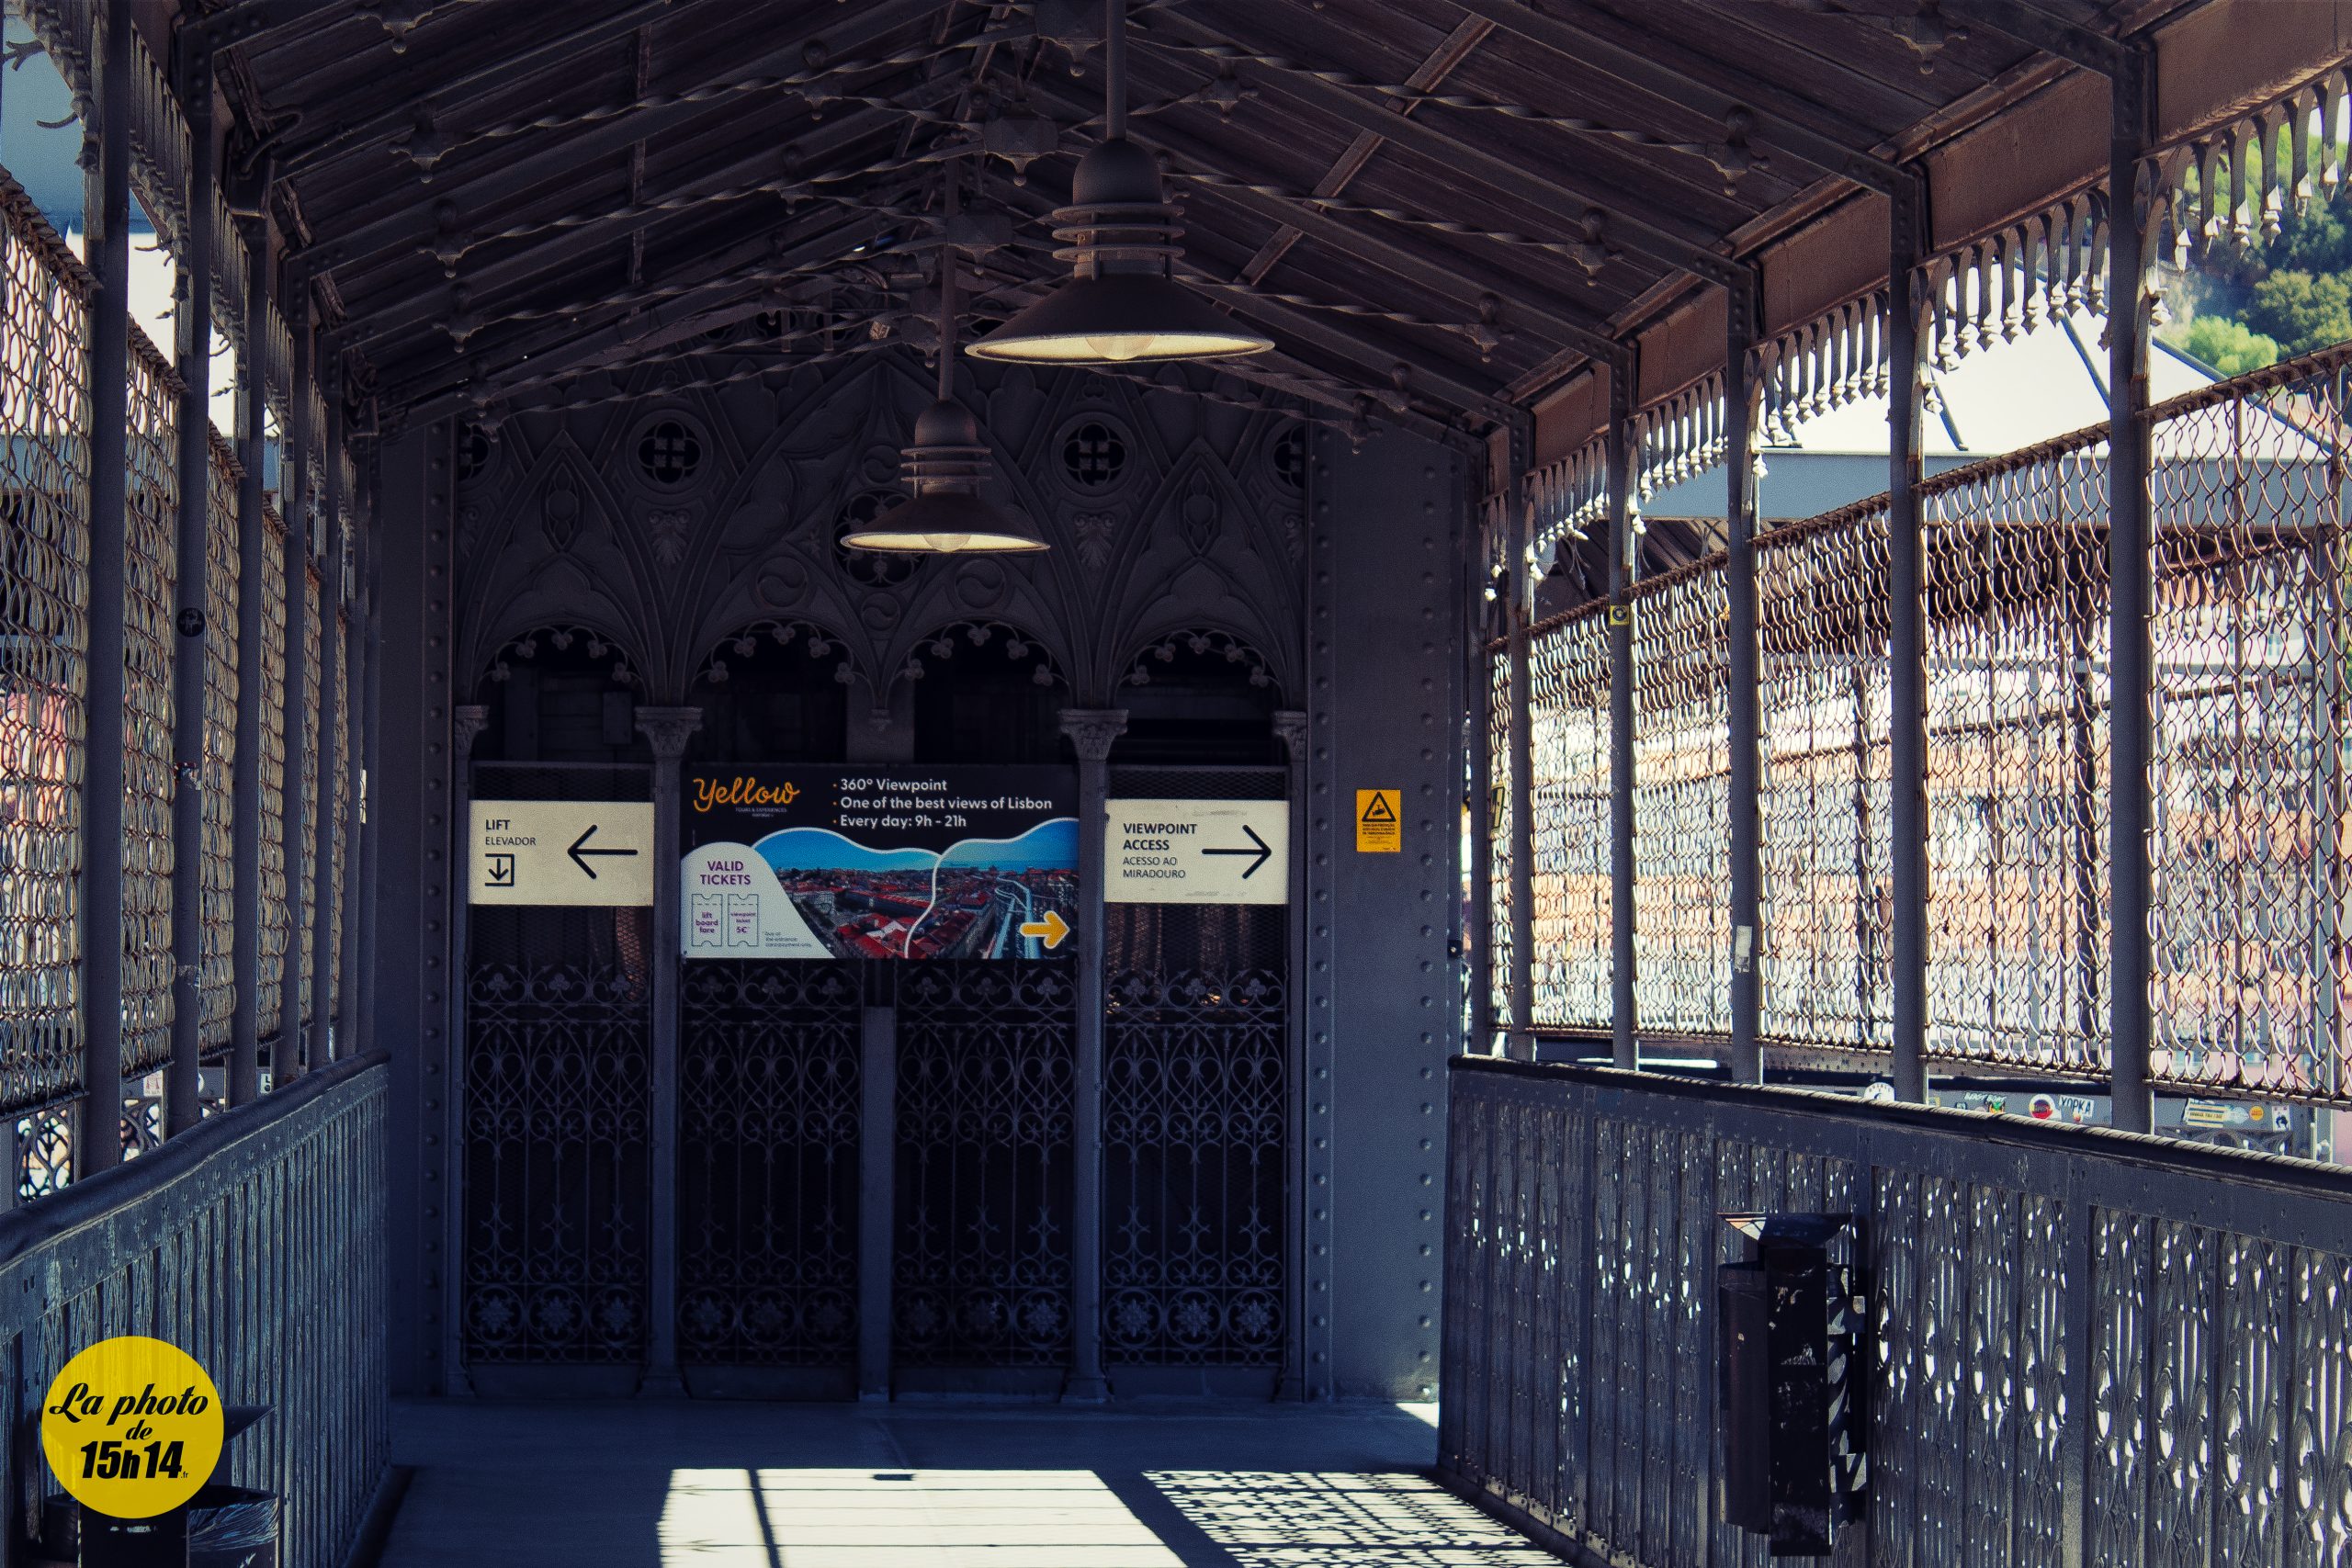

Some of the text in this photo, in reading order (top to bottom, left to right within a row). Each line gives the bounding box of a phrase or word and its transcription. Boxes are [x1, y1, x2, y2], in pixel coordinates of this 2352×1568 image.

[876, 778, 947, 794] Viewpoint
[693, 776, 801, 812] Yellow
[840, 795, 1052, 809] One of the best views of Lisbon
[485, 819, 511, 830] LIFT
[840, 814, 878, 829] Every
[881, 814, 912, 829] day:
[914, 814, 933, 827] 9h
[944, 814, 967, 827] 21h
[1123, 822, 1198, 834] VIEWPOINT
[485, 836, 537, 846] ELEVADOR
[1123, 839, 1170, 851] ACCESS
[707, 860, 744, 872] VALID
[1122, 856, 1178, 866] ACESSO AO
[1122, 868, 1186, 879] MIRADOURO
[699, 874, 752, 886] TICKETS
